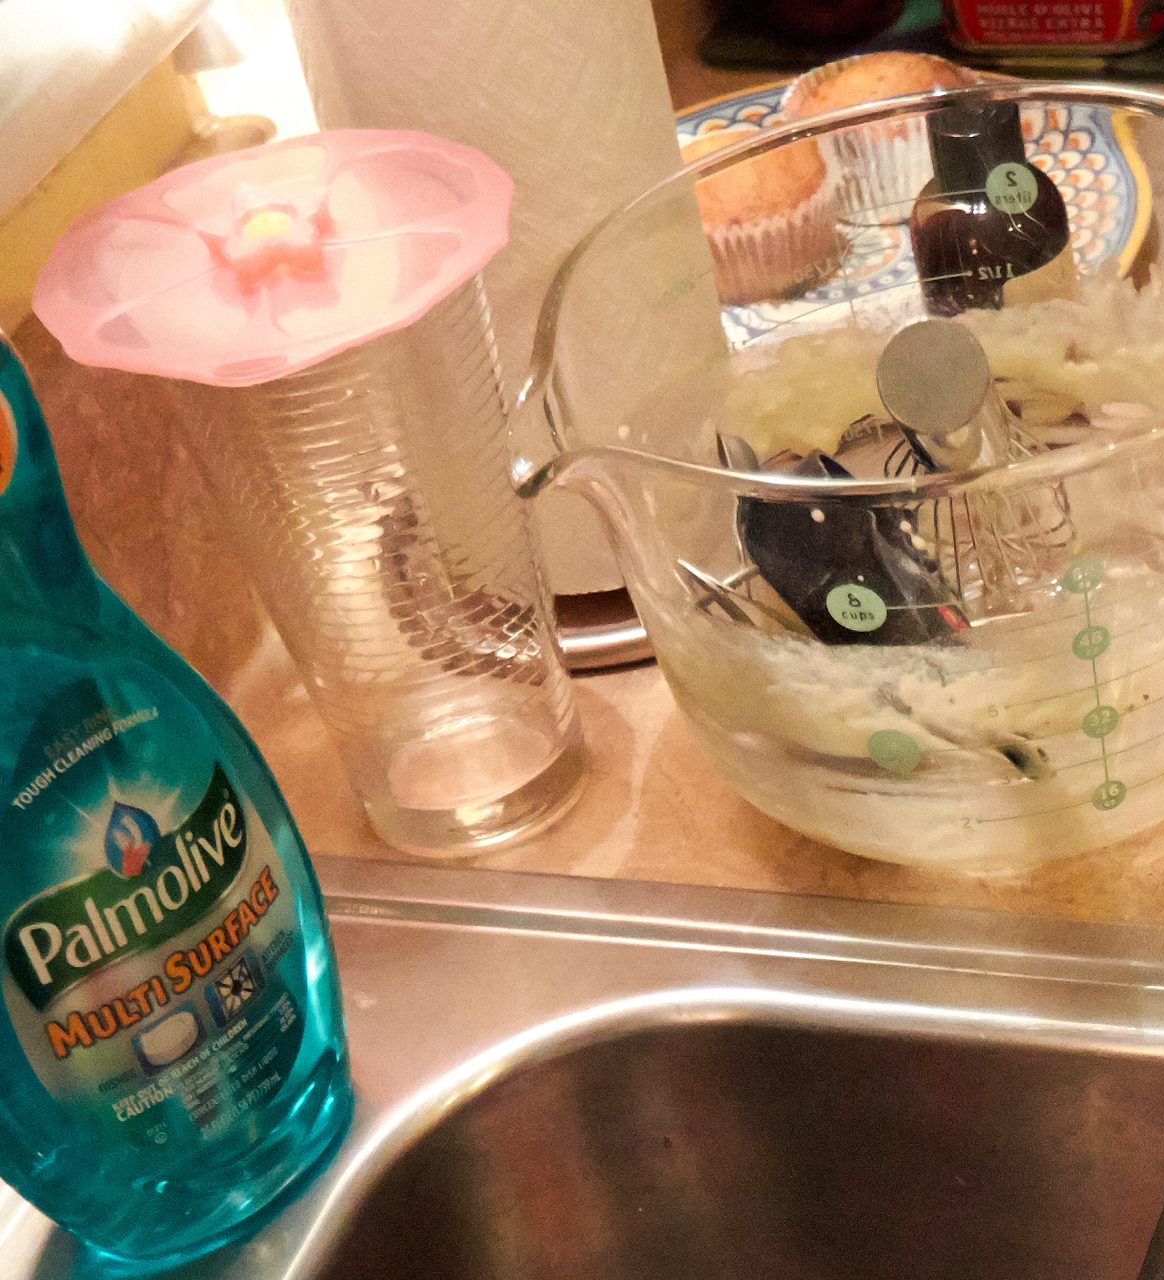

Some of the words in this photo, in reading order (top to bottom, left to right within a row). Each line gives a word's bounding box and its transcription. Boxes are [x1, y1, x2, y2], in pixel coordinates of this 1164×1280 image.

[841, 609, 875, 622] cups
[11, 767, 57, 810] TOUGH
[53, 727, 113, 773] CLEANING
[1101, 783, 1119, 800] 16
[19, 802, 243, 986] Palmolive
[48, 977, 168, 1058] MULTI
[164, 865, 280, 994] SURFACE
[117, 1087, 176, 1121] CAUTION
